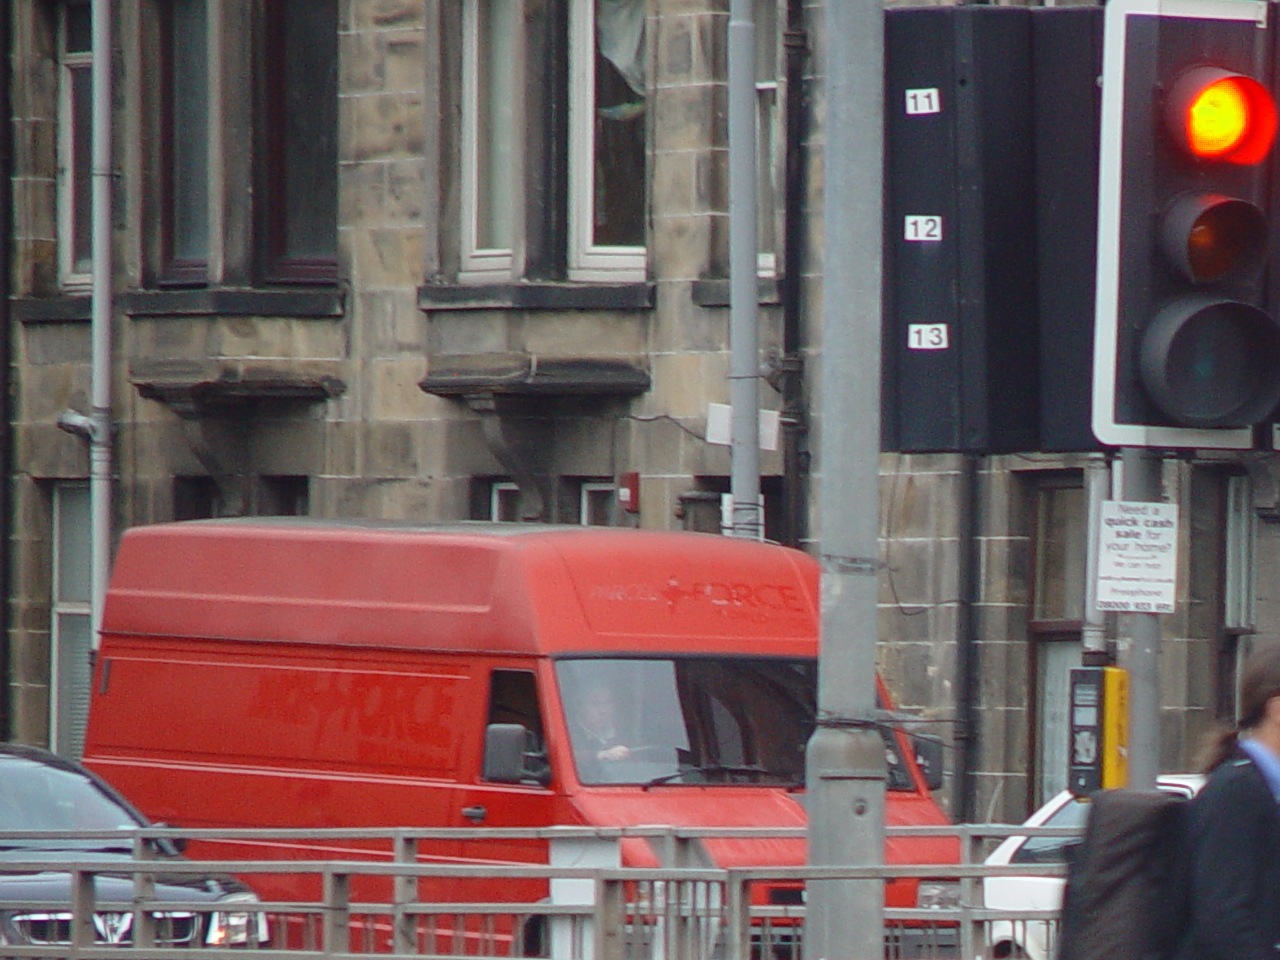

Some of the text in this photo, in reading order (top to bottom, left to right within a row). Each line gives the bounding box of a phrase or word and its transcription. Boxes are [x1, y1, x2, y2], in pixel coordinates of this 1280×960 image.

[909, 92, 934, 111] 11
[910, 217, 937, 238] 12
[912, 326, 944, 346] 13
[1104, 516, 1174, 529] quick cash
[1115, 528, 1142, 540] sale
